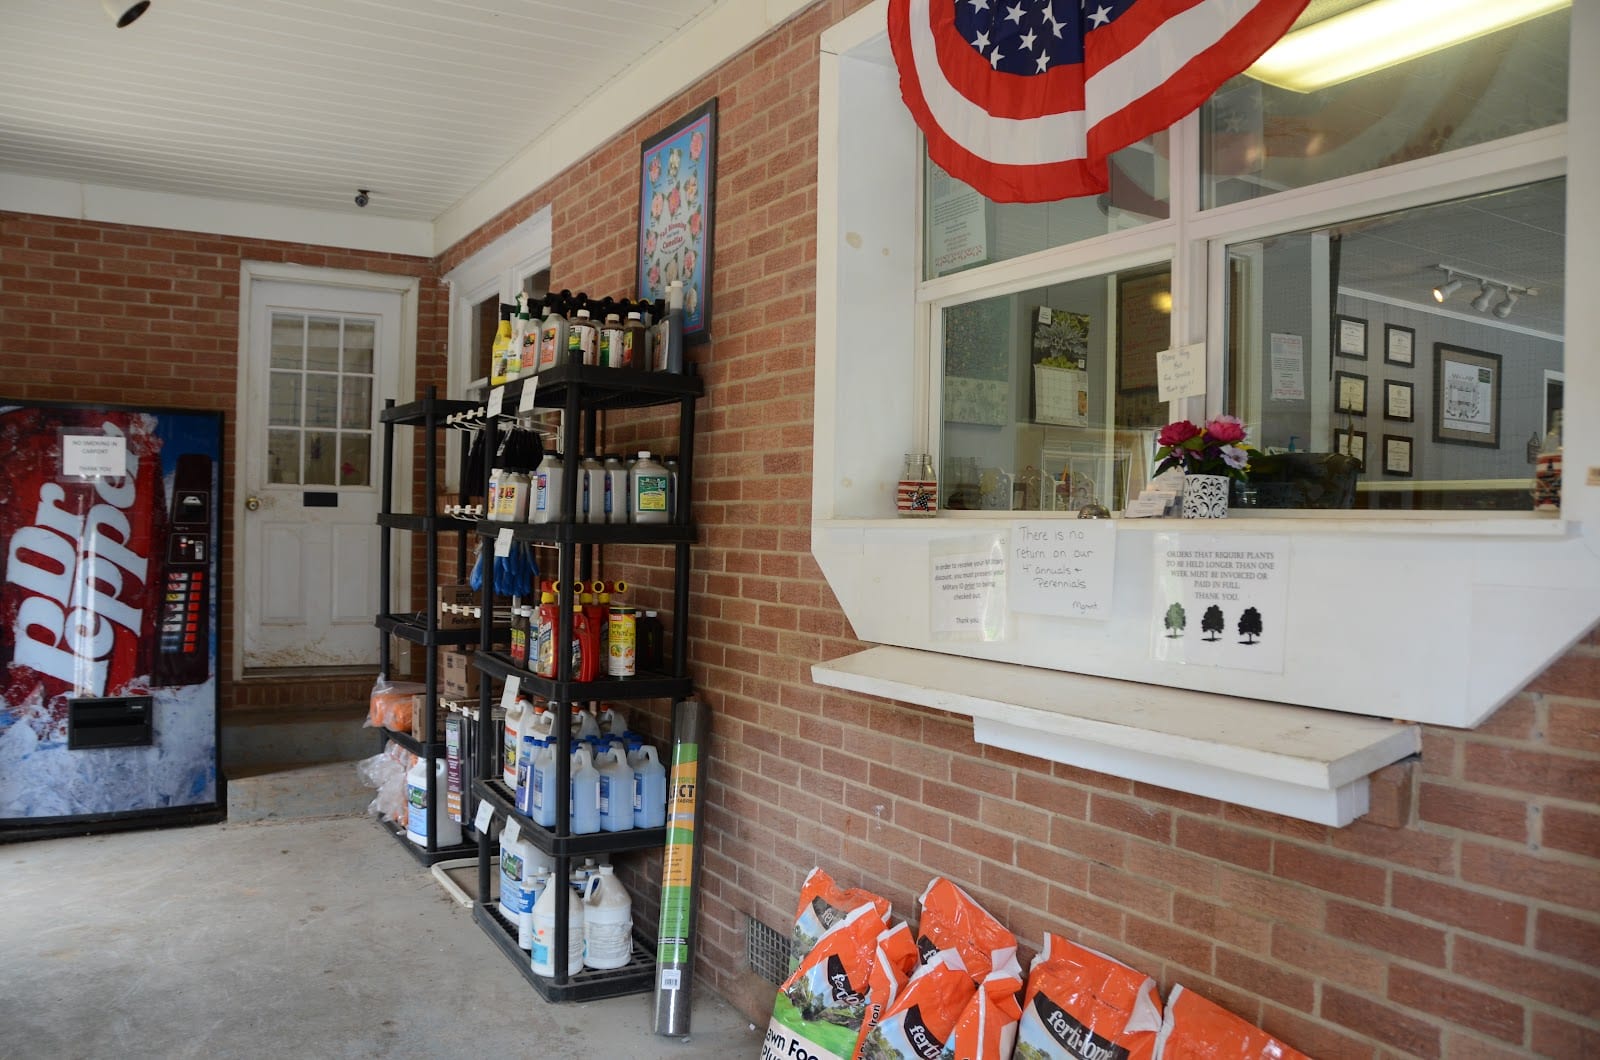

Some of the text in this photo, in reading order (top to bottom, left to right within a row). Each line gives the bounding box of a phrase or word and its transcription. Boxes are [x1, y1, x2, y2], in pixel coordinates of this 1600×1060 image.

[1019, 526, 1084, 542] There is no
[6, 482, 84, 606] Dr
[1016, 547, 1094, 559] return on our
[1166, 550, 1275, 560] ORDERS THAT REQUIRE PLANTS
[1034, 563, 1072, 576] annuals
[1166, 560, 1276, 570] TO BE HELD LONGER THAN ONE
[1171, 570, 1269, 581] WEEK MUST BE INVOICED OR
[1032, 577, 1088, 589] Perennials
[1193, 580, 1211, 589] PAID
[1212, 581, 1221, 589] IN
[1194, 591, 1220, 600] THANK
[867, 1004, 881, 1028] Iron
[766, 1028, 786, 1052] awn
